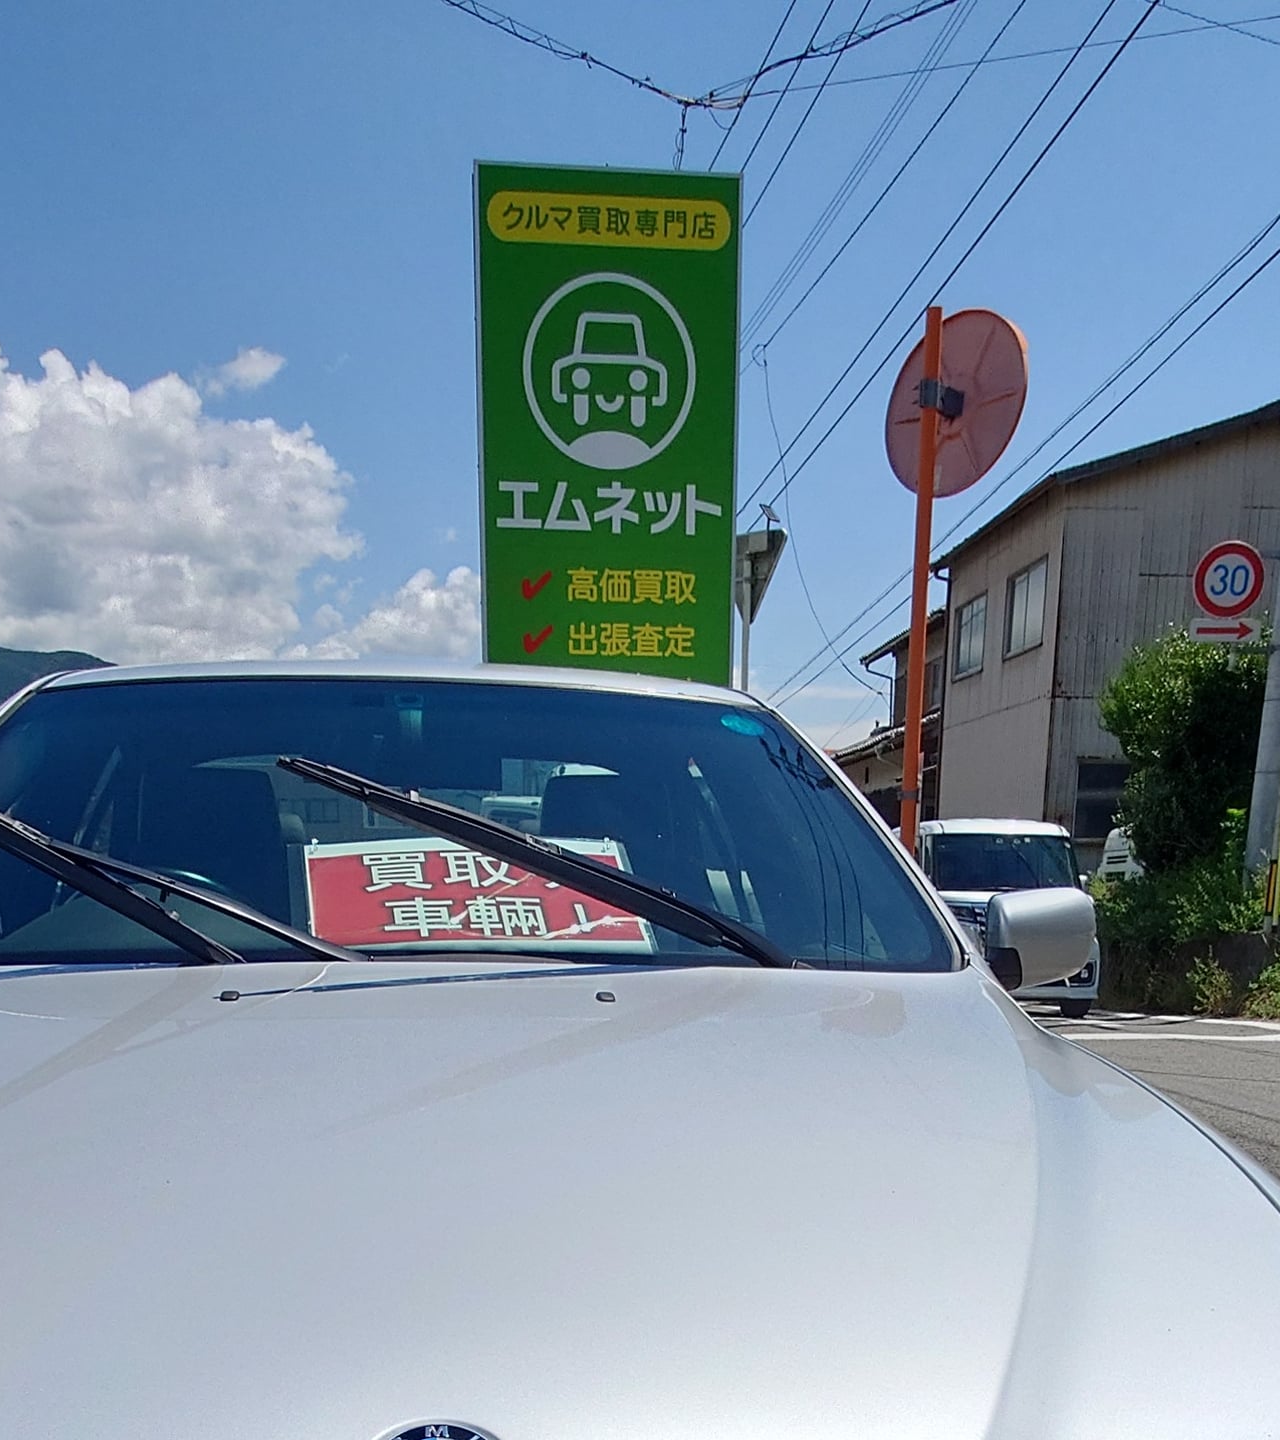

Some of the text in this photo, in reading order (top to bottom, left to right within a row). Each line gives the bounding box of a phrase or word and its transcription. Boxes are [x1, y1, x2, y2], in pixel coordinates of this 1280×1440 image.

[500, 200, 716, 240] クルマ買取専門店
[495, 480, 722, 536] エムネット
[566, 567, 697, 605] 高価買取
[1210, 564, 1250, 596] 30
[567, 621, 696, 658] 出張査定
[361, 851, 562, 891] 買取
